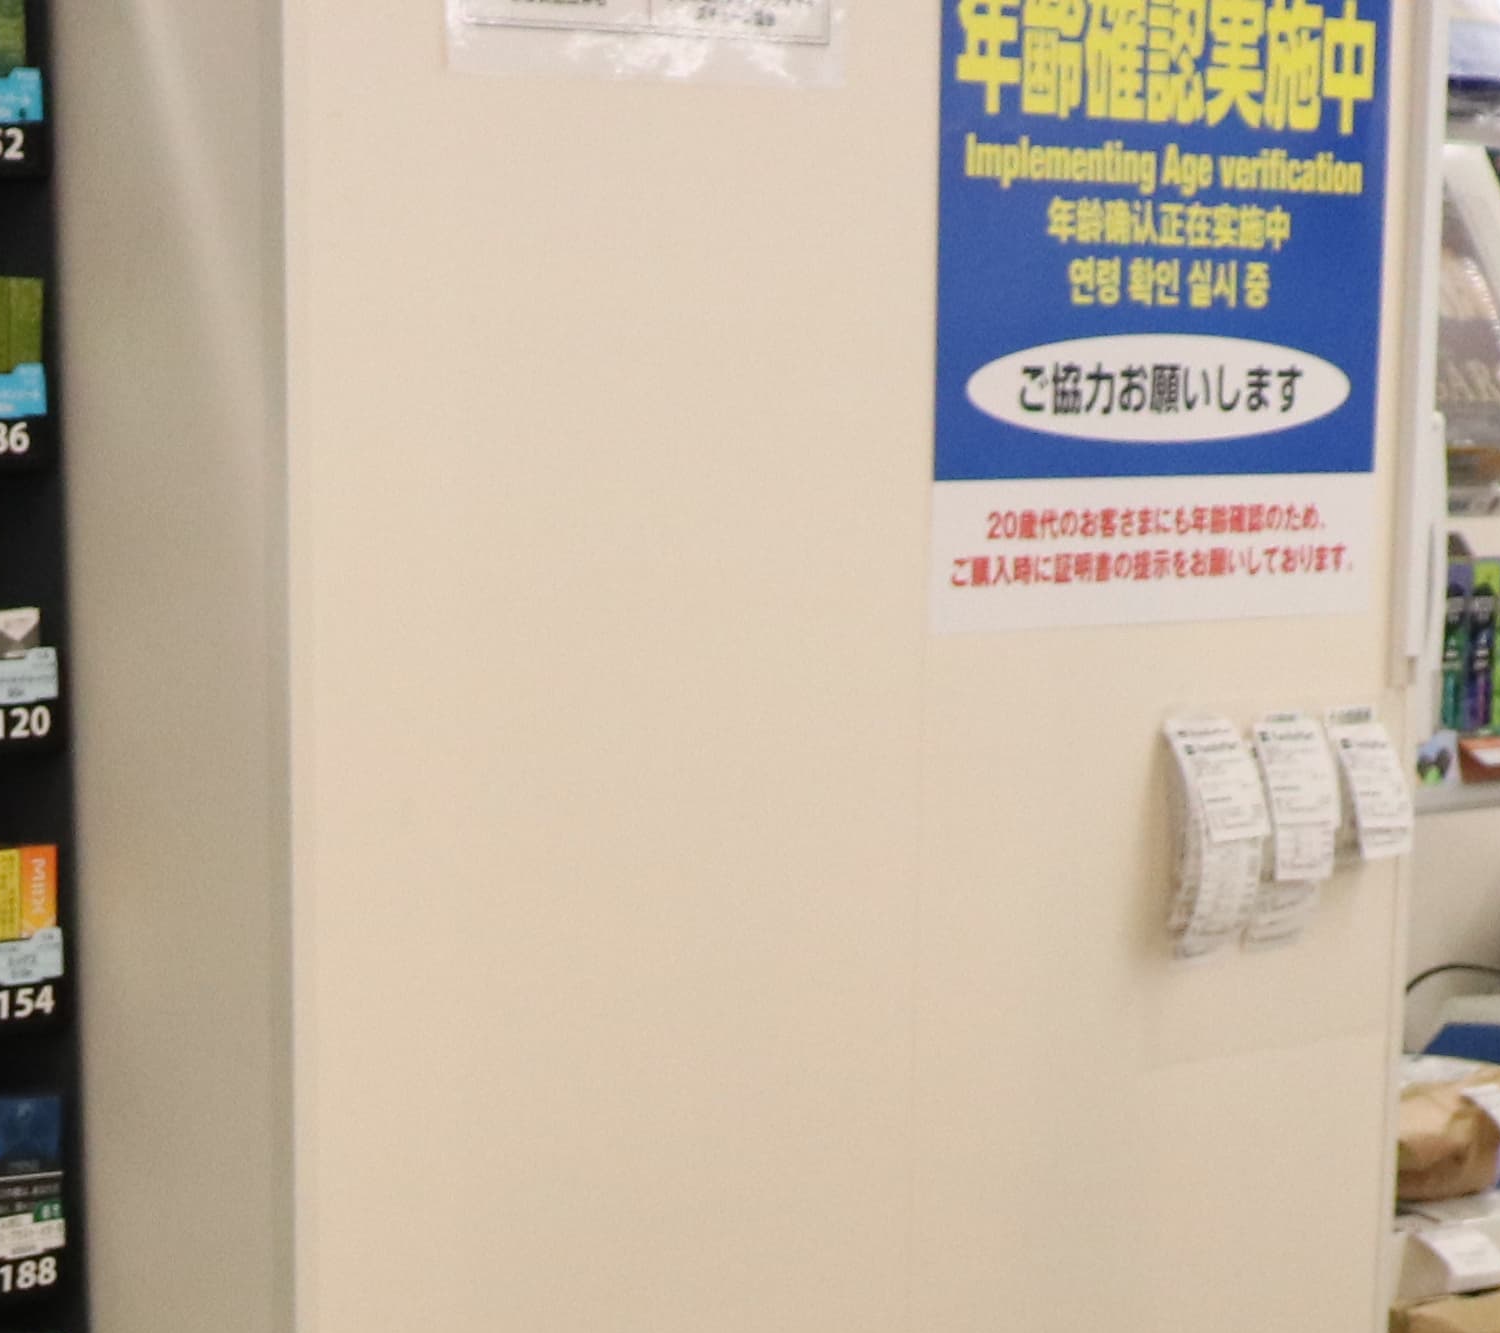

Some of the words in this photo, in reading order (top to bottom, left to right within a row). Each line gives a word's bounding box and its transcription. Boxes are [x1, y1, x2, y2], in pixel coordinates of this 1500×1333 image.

[965, 133, 1157, 195] Implementing
[1161, 144, 1213, 196] Age
[1219, 149, 1363, 194] verification
[1069, 257, 1121, 305] 연령
[1128, 258, 1180, 306] 확인
[1188, 261, 1238, 308] 실시
[1244, 262, 1270, 307] 중
[1019, 363, 1303, 415] ご協力お願いします
